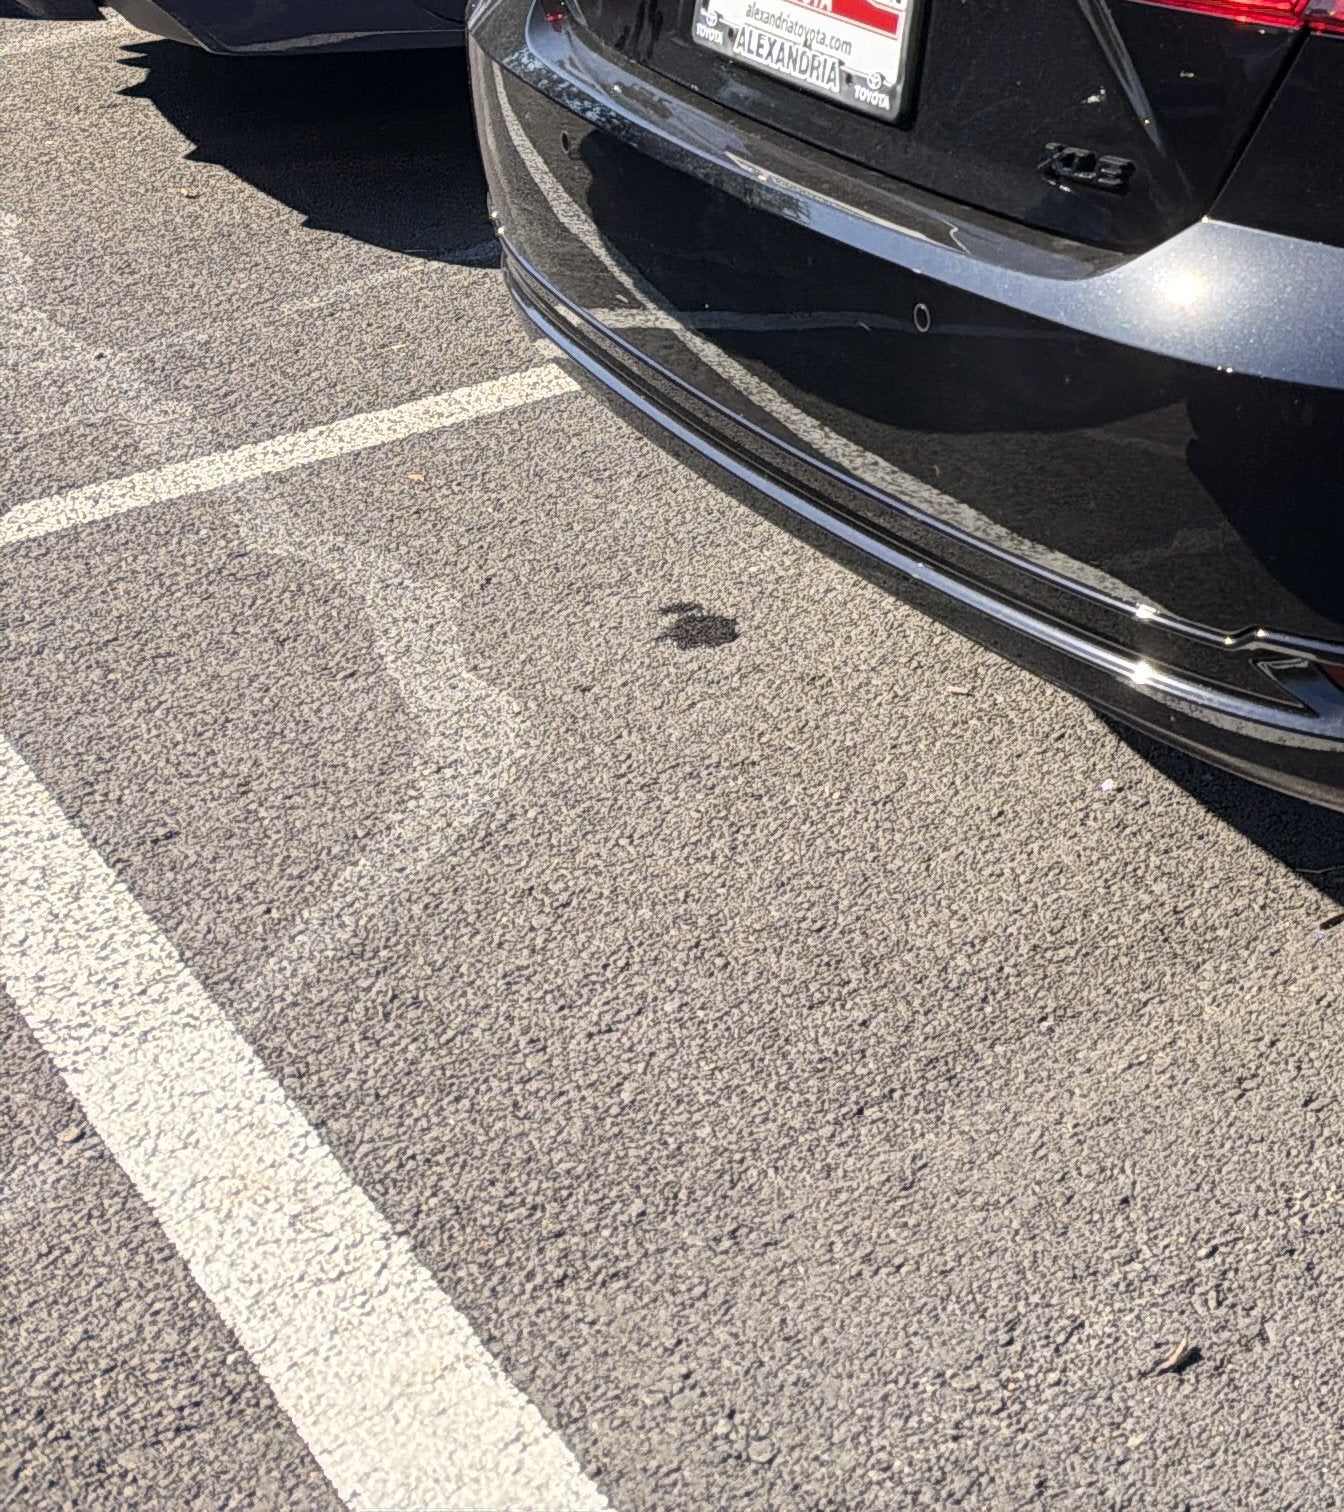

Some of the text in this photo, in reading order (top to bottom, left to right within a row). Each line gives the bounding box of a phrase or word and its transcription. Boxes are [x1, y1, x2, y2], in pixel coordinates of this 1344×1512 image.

[695, 22, 725, 46] TOYOTA
[745, 1, 853, 56] alexandriatoyota.com
[734, 26, 841, 92] ALEXANDRIA
[853, 84, 891, 111] TOYOTA
